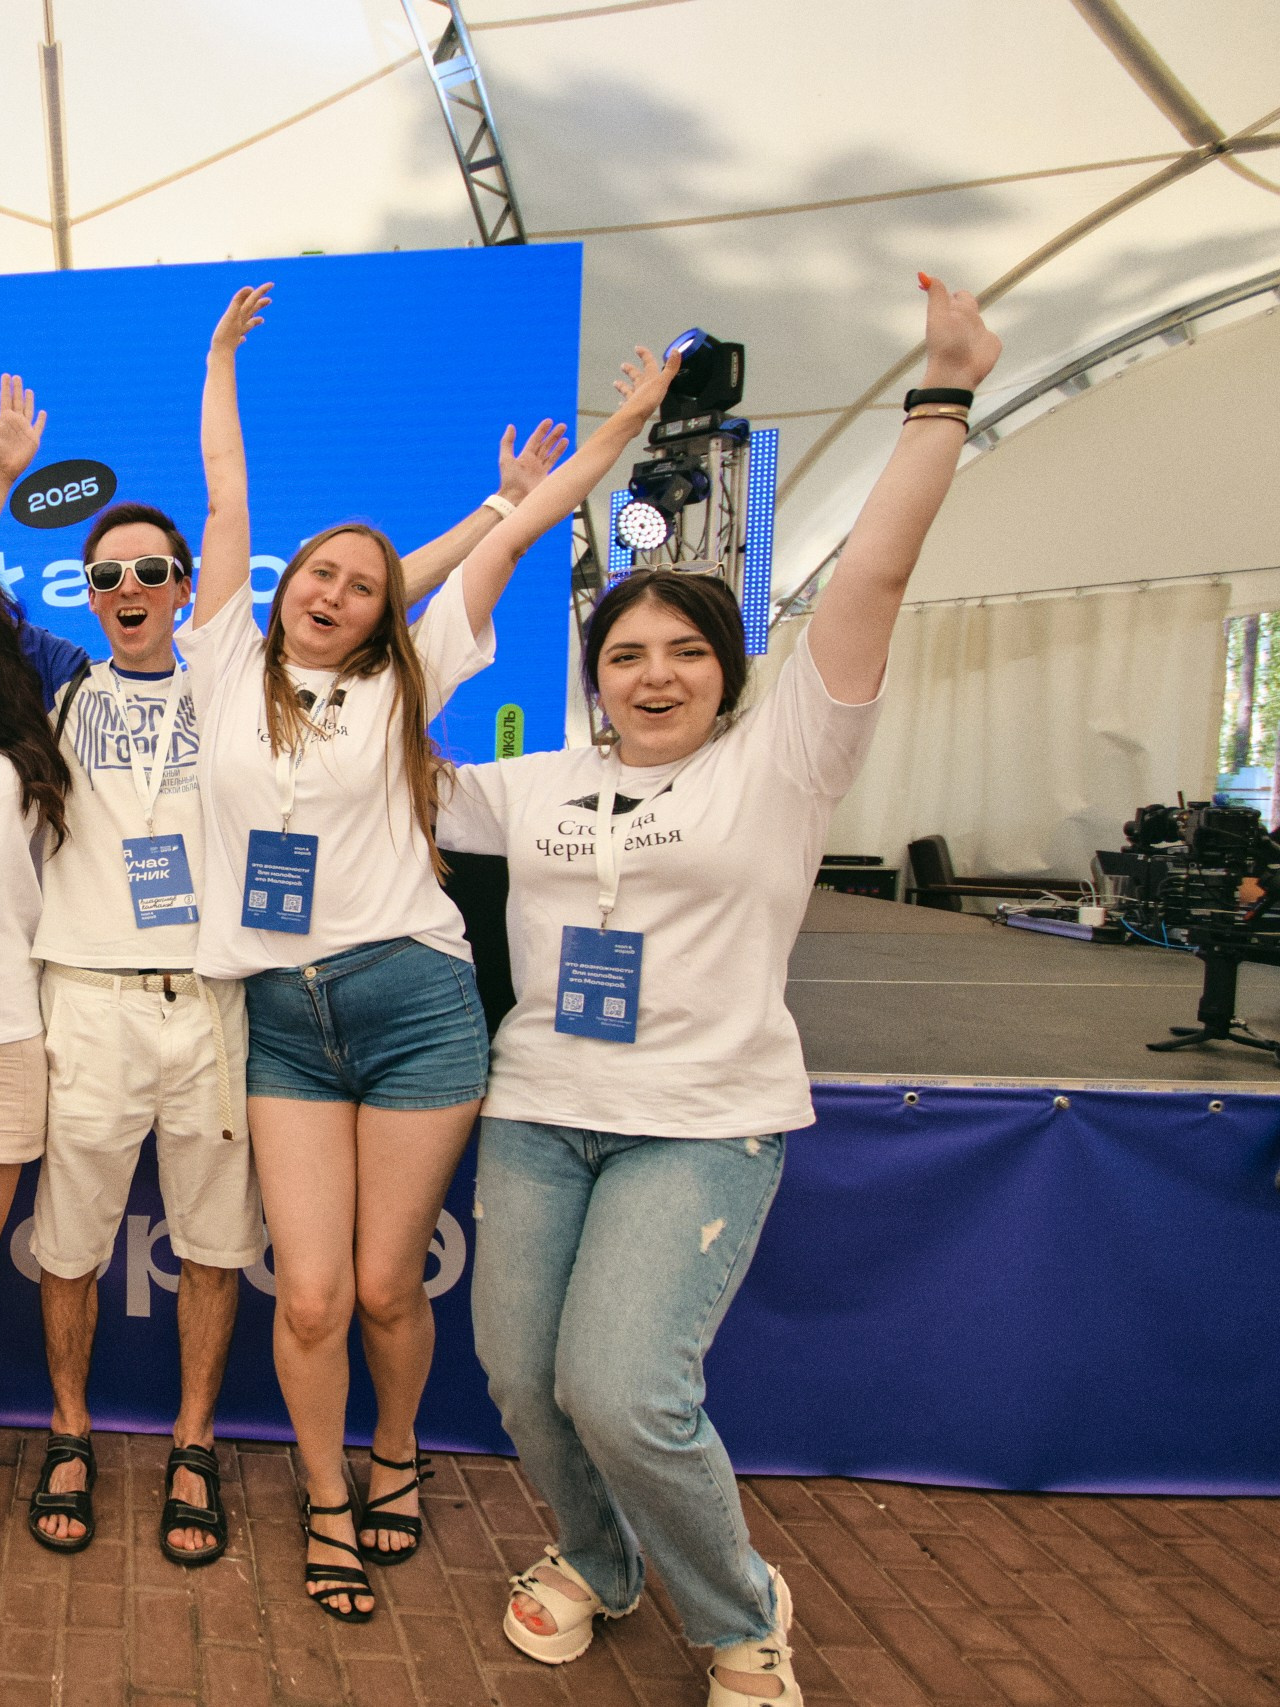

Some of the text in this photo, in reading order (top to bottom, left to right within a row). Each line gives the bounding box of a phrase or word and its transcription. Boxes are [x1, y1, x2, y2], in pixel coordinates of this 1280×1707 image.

[28, 477, 98, 512] 2025
[536, 829, 684, 862] Чернемья
[125, 857, 170, 873] учас
[128, 869, 171, 882] тник
